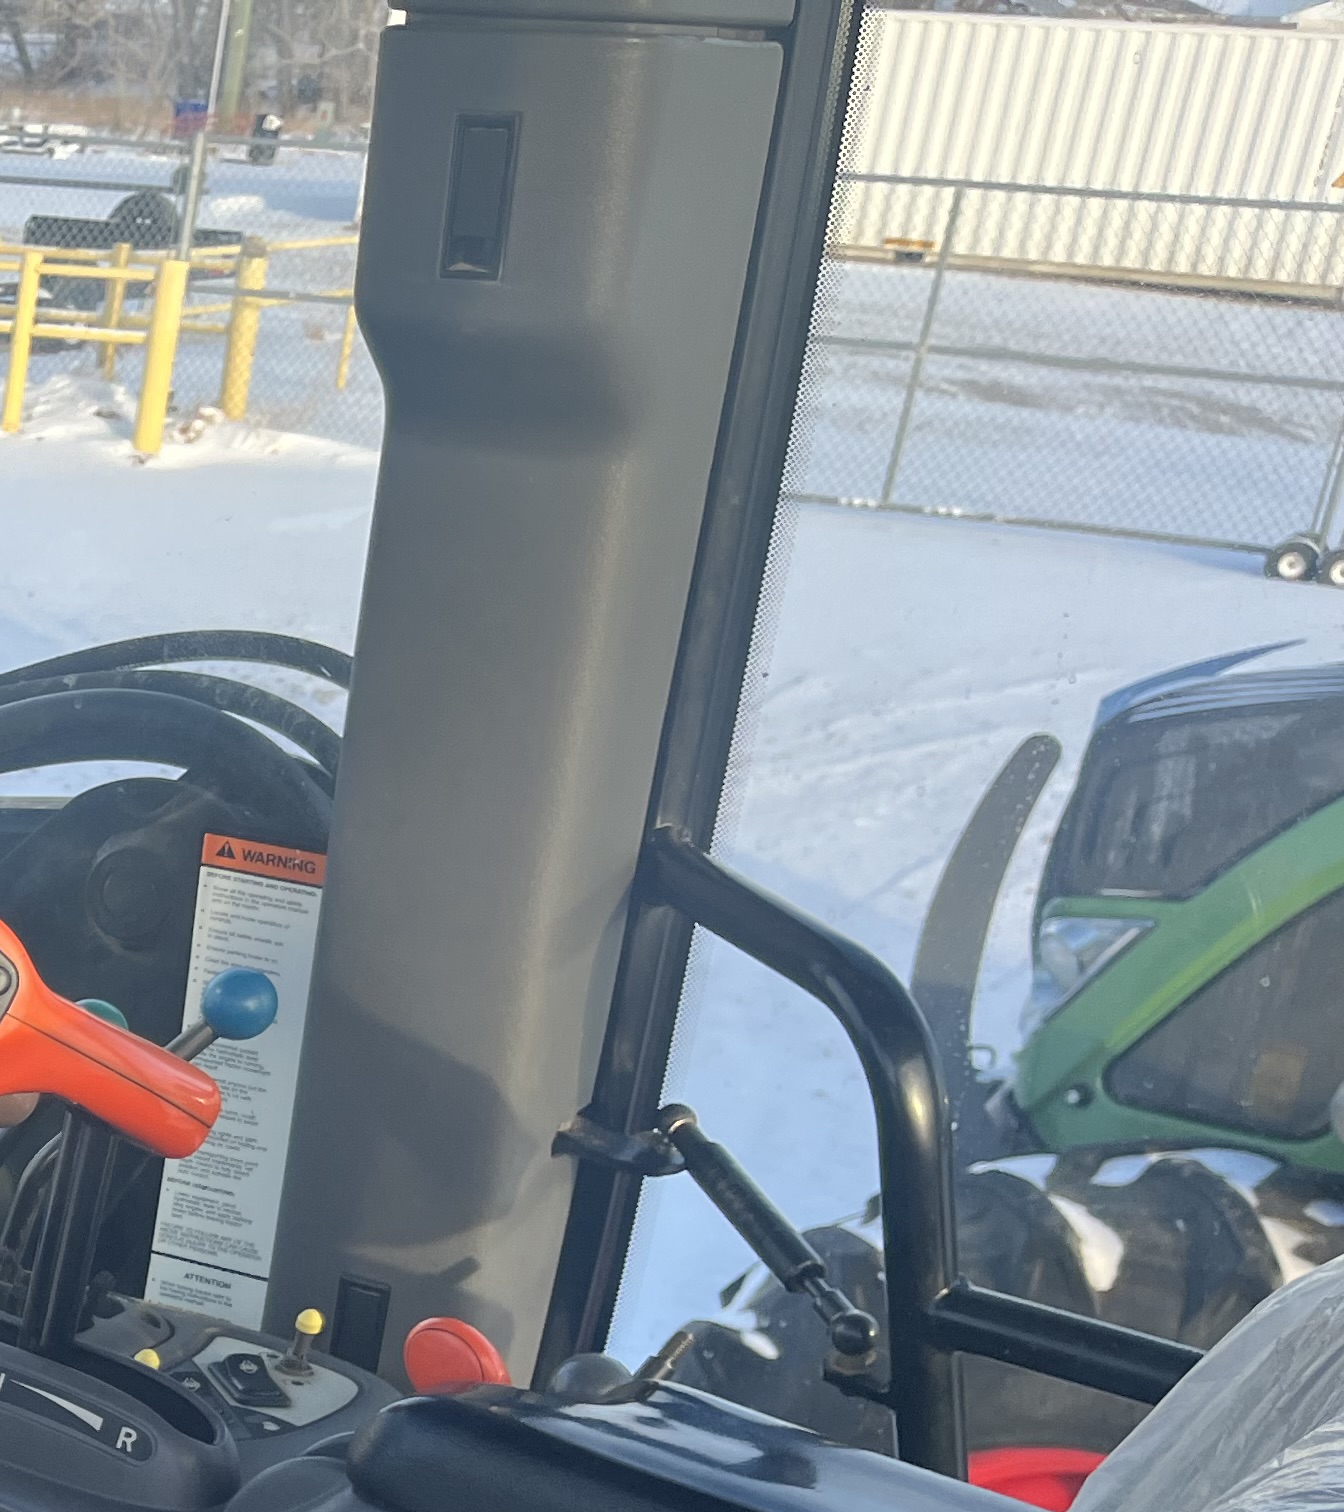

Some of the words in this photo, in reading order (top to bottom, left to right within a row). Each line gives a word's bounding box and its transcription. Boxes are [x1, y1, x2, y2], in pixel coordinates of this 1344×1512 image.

[241, 847, 316, 874] WARNING
[183, 1272, 232, 1289] ATTENTION
[115, 1426, 137, 1453] R
